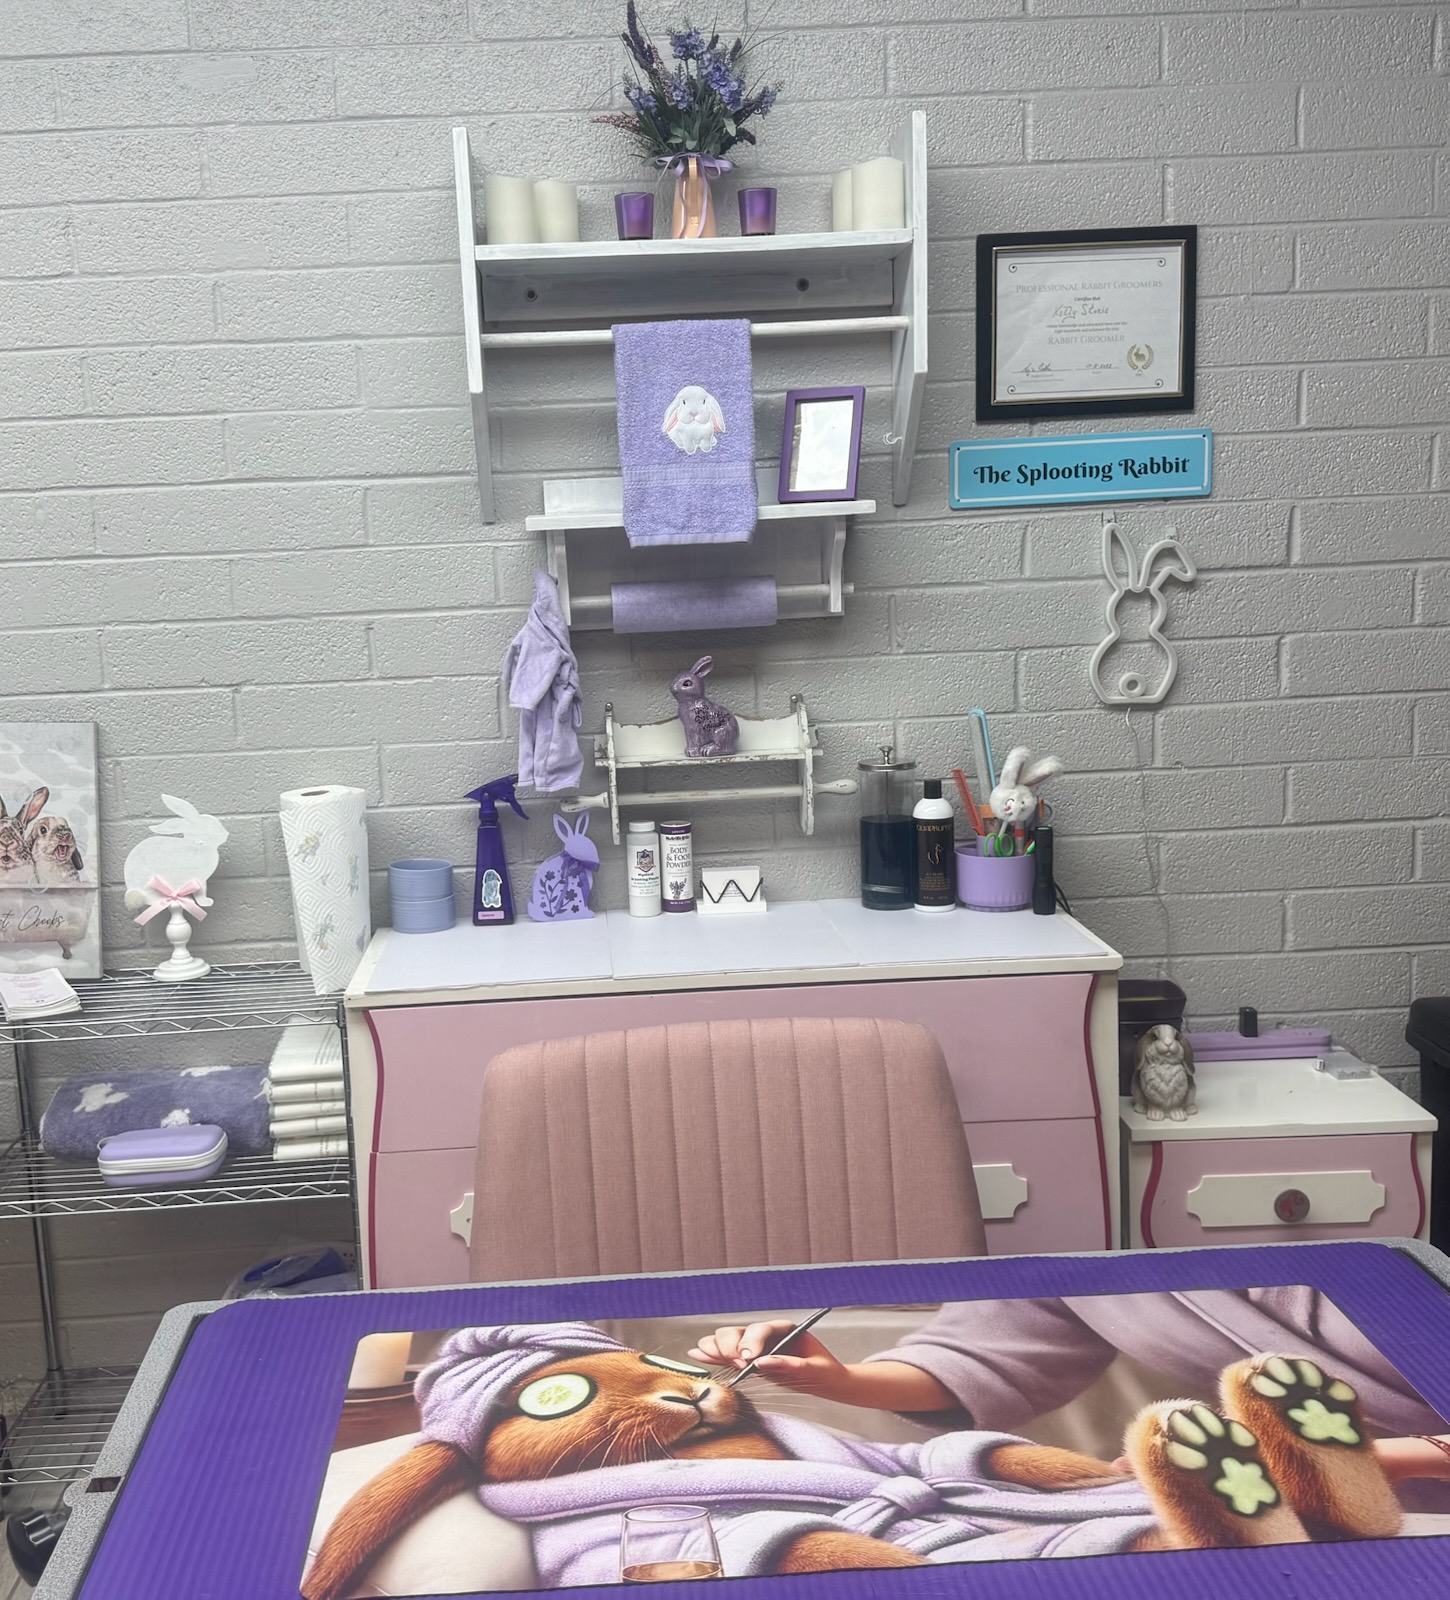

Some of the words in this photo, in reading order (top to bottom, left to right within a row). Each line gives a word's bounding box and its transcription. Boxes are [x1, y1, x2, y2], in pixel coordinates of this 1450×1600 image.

[1016, 284, 1078, 293] PROFESSIONAL
[1081, 282, 1111, 291] RABBIT
[1113, 280, 1163, 289] GROOMERS
[1048, 336, 1078, 345] RABBIT
[1080, 334, 1125, 344] GROOMER
[973, 465, 1012, 484] The
[1016, 461, 1113, 486] Splooting
[1118, 456, 1190, 479] Rabbit
[666, 853, 673, 861] &
[18, 905, 65, 931] Cheeks
